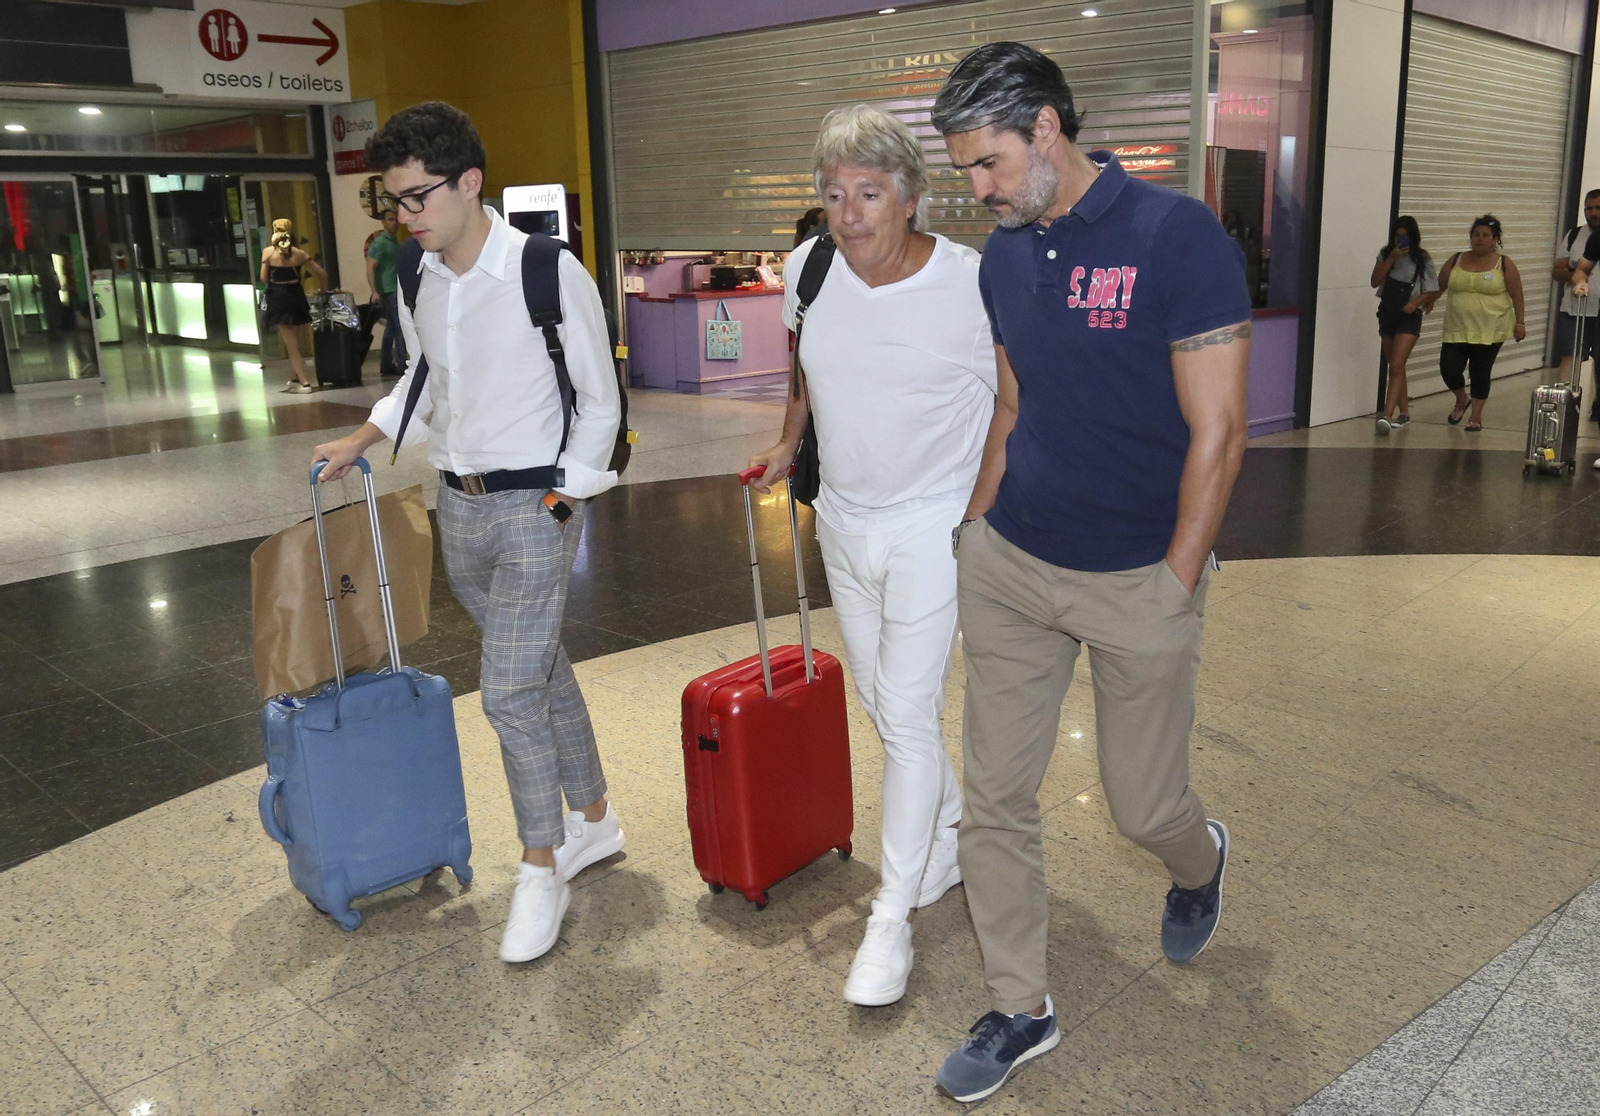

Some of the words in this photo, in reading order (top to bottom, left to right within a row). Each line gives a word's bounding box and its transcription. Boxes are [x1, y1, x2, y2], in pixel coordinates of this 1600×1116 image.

[203, 72, 263, 89] aseos
[268, 71, 274, 88] /
[279, 73, 344, 92] toilets
[529, 188, 558, 208] renfe
[1067, 265, 1138, 309] S.DRY
[1088, 310, 1127, 329] 523
